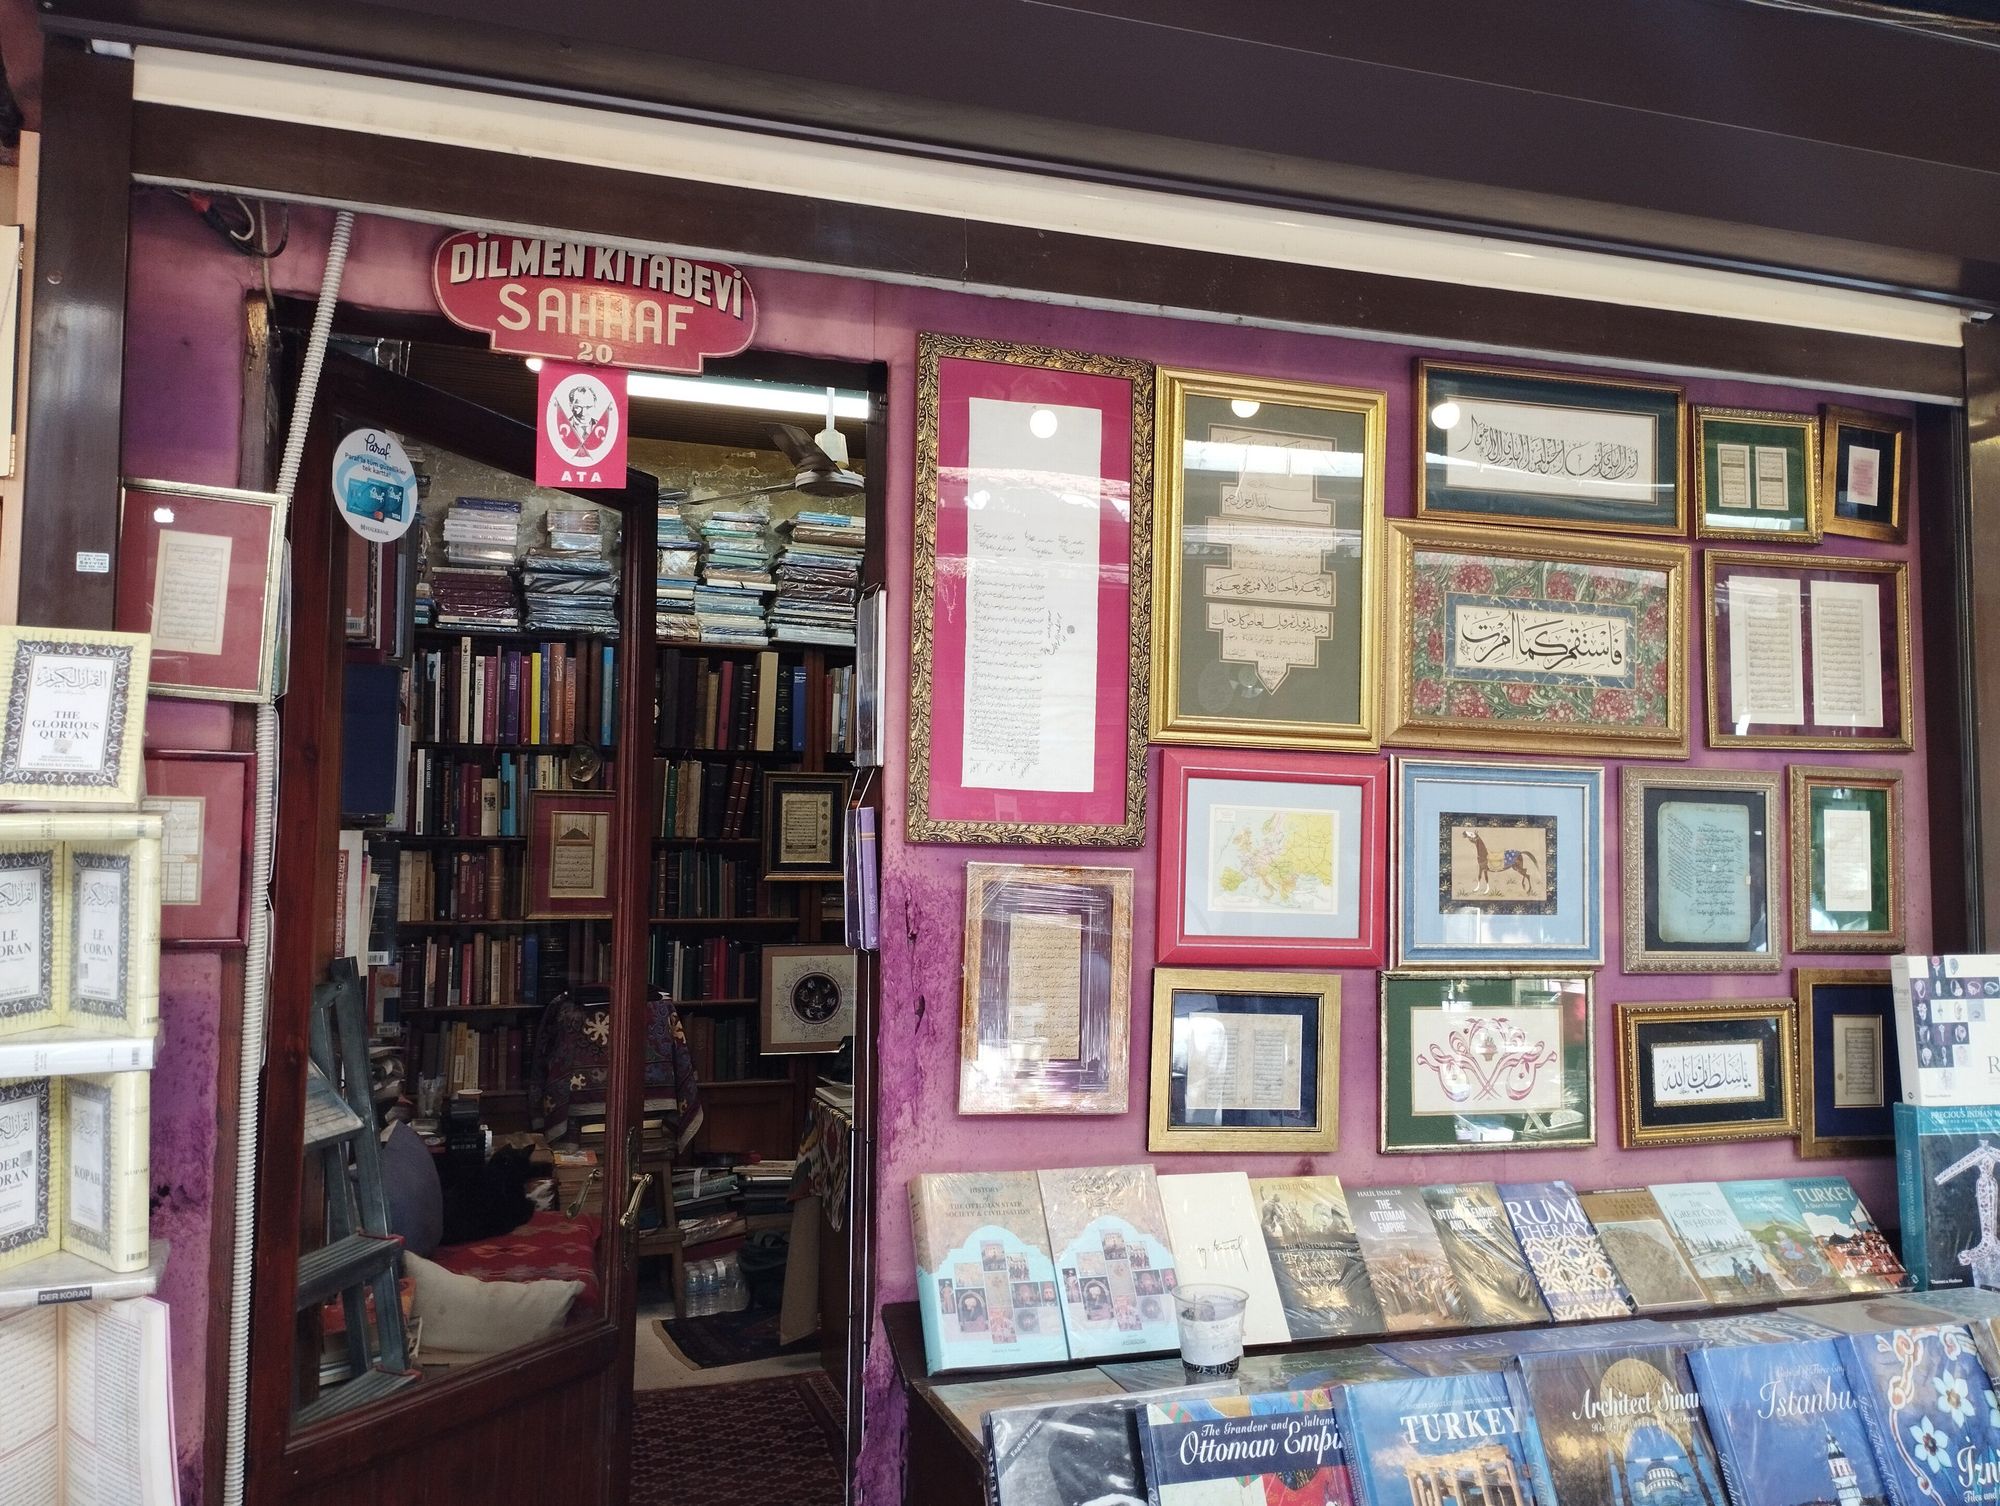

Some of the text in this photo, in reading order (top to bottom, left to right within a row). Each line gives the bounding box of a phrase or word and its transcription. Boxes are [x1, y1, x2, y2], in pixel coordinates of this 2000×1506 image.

[450, 232, 585, 284] DİLMEN
[497, 283, 694, 346] SAHHAF
[577, 341, 613, 363] 20
[365, 433, 391, 460] Paraf
[561, 471, 603, 483] ATA
[54, 710, 80, 720] THE
[32, 719, 100, 731] GLORIOUS
[2, 929, 19, 942] LE
[93, 929, 105, 941] LE
[0, 942, 32, 957] ORAN
[83, 943, 114, 956] CORAN
[1930, 1109, 1966, 1119] PRECIOUS
[1966, 1109, 1992, 1118] INDIAN
[1454, 1196, 1472, 1207] THE
[1793, 1187, 1854, 1203] TURKEY
[1376, 1199, 1392, 1210] THE
[984, 1208, 1031, 1217] CIVILISATION
[1369, 1209, 1407, 1222] OTTOMAN
[1504, 1198, 1587, 1226] RUMI
[1674, 1208, 1699, 1218] GREAT
[1378, 1222, 1408, 1233] EMPIRE
[1450, 1220, 1466, 1231] AND
[1694, 1218, 1727, 1228] HISTORY
[1515, 1222, 1593, 1240] THERAPY
[40, 1289, 91, 1303] DER KORAN
[1408, 1338, 1506, 1355] TURKEY
[1572, 1387, 1653, 1420] Architect
[1201, 1424, 1221, 1438] The
[1224, 1421, 1268, 1435] Grandeur
[1271, 1416, 1289, 1431] and
[1400, 1406, 1521, 1444] TURKEY
[1010, 1420, 1042, 1457] English Edition
[1180, 1430, 1279, 1466] Ottoman
